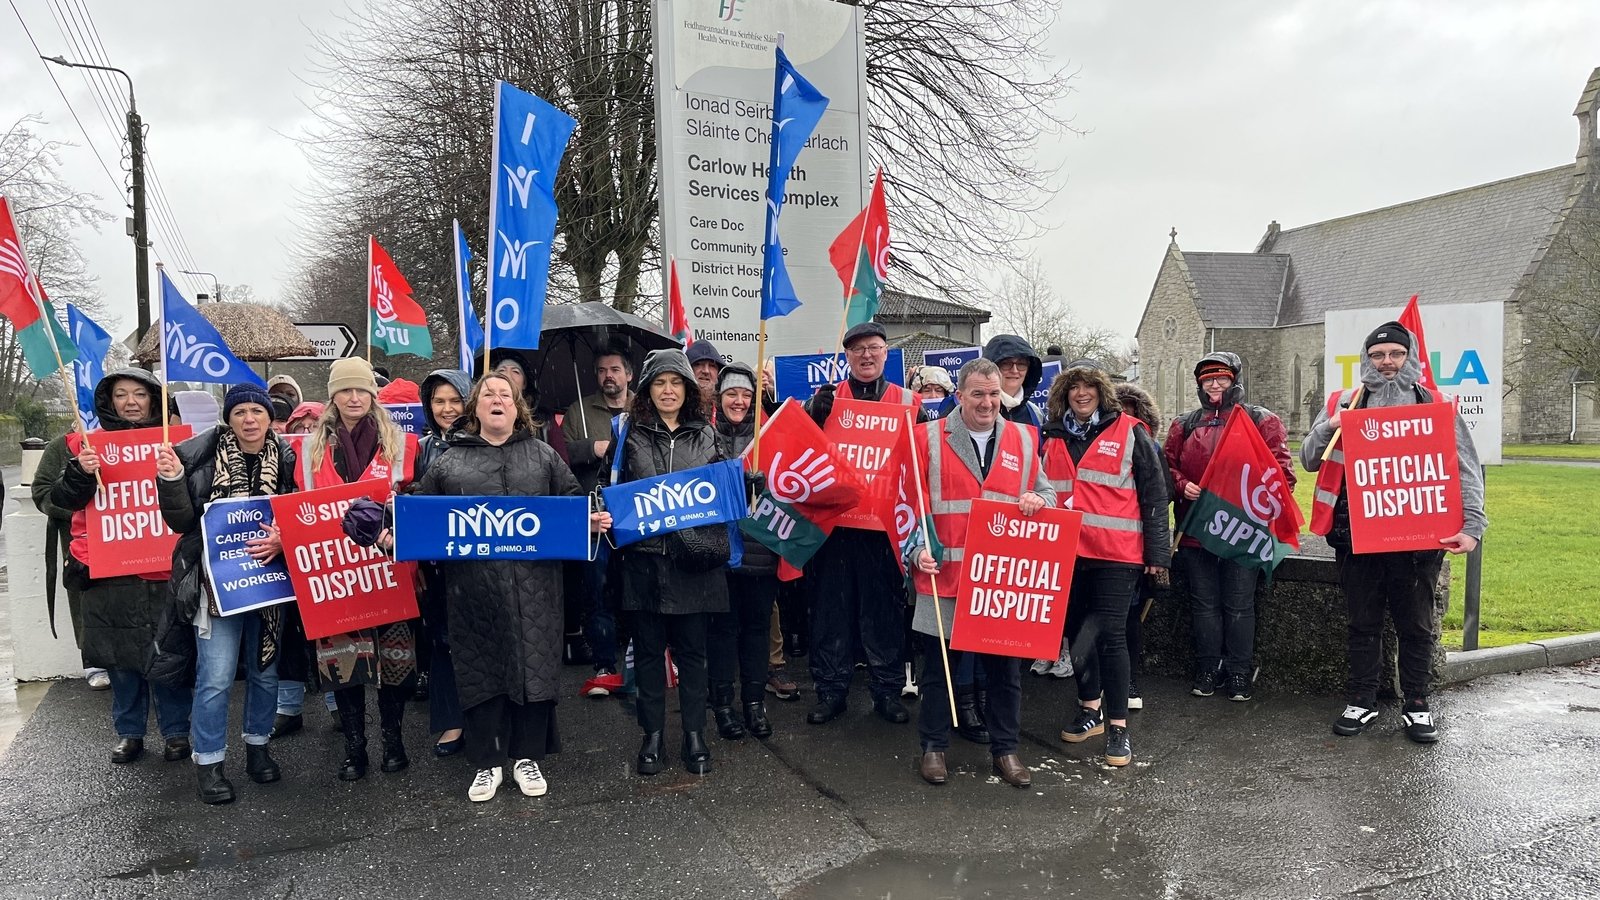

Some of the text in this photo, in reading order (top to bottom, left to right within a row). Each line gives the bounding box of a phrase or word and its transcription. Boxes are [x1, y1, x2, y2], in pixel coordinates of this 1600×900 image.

[684, 20, 729, 36] Feidhmeannacht
[730, 28, 737, 37] na
[763, 34, 777, 43] Sláin
[698, 32, 768, 52] Health Service Executive
[686, 93, 774, 120] Ionad Seirb
[686, 119, 740, 141] Sláinte
[688, 154, 806, 182] Carlow Heth
[689, 180, 760, 202] Services
[690, 216, 745, 232] Care Doc
[690, 239, 758, 257] Community
[692, 261, 734, 276] District
[693, 284, 728, 297] Kelvin
[693, 306, 730, 319] CAMS
[309, 338, 337, 348] heach
[807, 355, 851, 382] INM
[1335, 350, 1490, 390] TLA
[1463, 395, 1482, 403] um
[855, 414, 898, 432] SIPTU
[1381, 417, 1434, 439] SIPTU
[122, 443, 172, 463] SIPT
[1354, 452, 1451, 487] OFFICIAL
[634, 477, 717, 519] INMO
[1362, 485, 1448, 518] DISPUTE
[227, 508, 263, 525] INMO
[318, 498, 356, 521] SIP
[448, 502, 541, 537] INMO
[680, 509, 719, 523] @INMO_IRL
[101, 509, 173, 543] DISPU
[1008, 518, 1060, 542] SIPTU
[1383, 533, 1436, 543] www.siptu.ie
[294, 536, 384, 574] OFFICIA
[494, 544, 538, 554] @INMO_IRL
[121, 556, 172, 565] www.siptu.i
[239, 559, 265, 571] THE
[222, 572, 287, 592] WORKERS
[307, 560, 398, 605] DISPUTE
[969, 552, 1062, 592] OFFICIAL
[969, 587, 1055, 624] DISPUTE
[336, 608, 389, 625] www.siptu.ie
[981, 637, 1032, 648] www.siptu.ie
